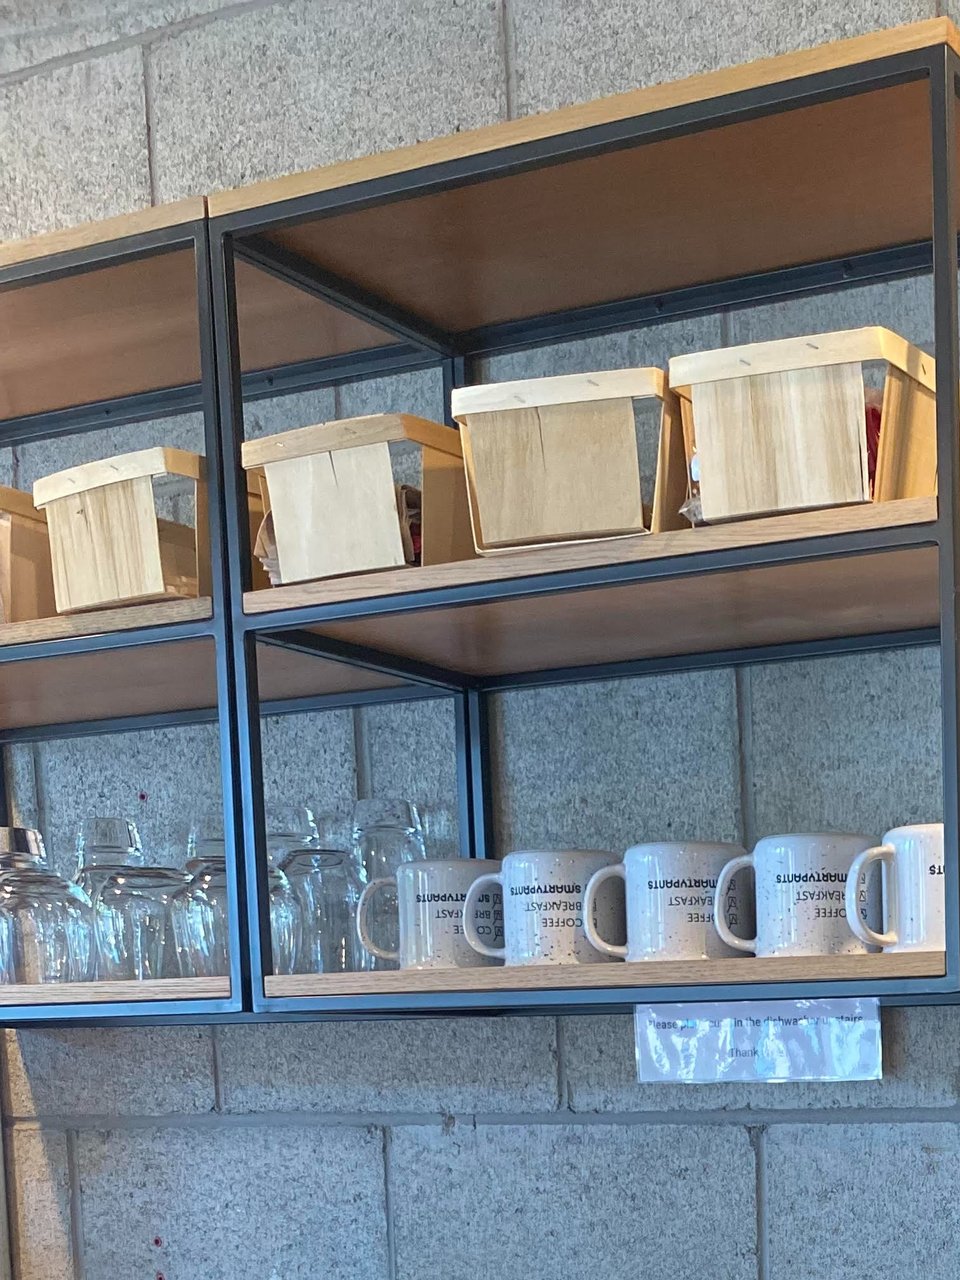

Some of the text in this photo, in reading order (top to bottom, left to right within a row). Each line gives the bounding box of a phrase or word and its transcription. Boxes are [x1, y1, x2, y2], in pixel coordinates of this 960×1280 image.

[511, 884, 582, 896] SMARTYPANTS
[525, 901, 582, 912] BREAKFAST
[815, 907, 846, 918] OFFEE
[542, 917, 583, 928] COFFEE
